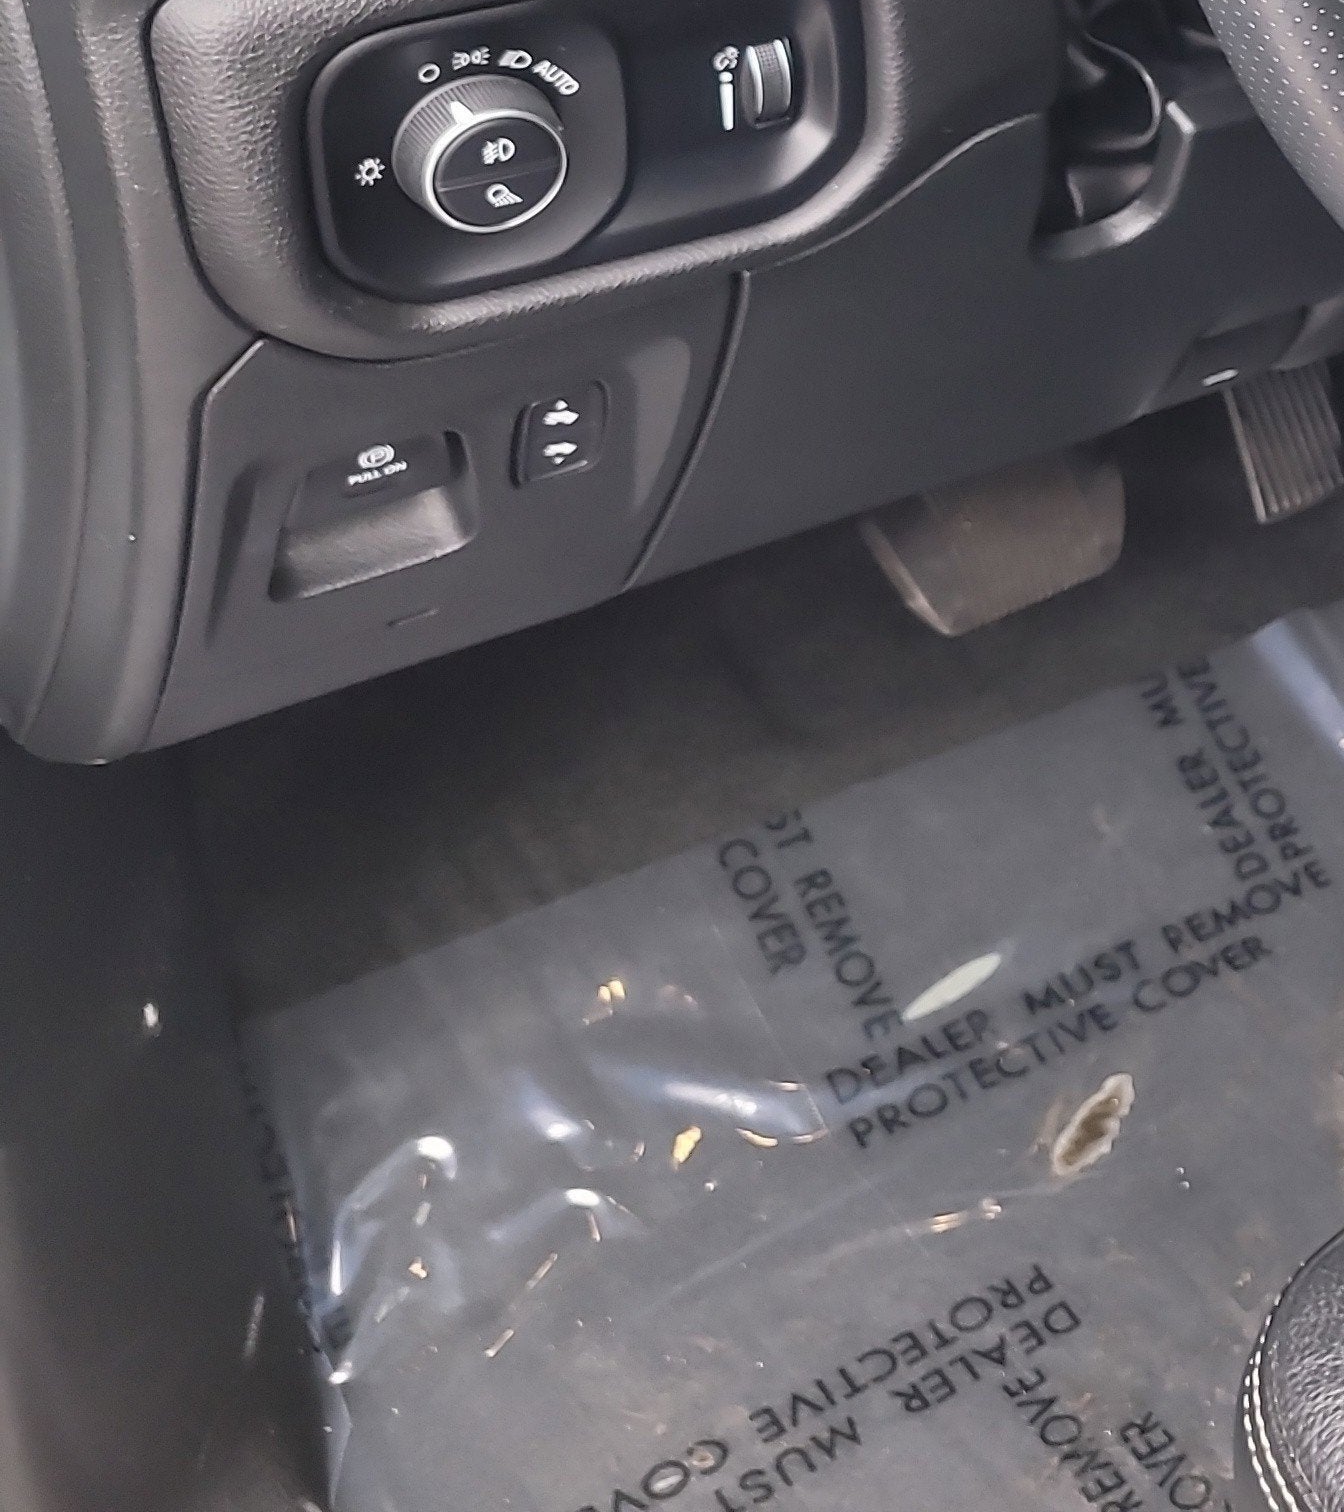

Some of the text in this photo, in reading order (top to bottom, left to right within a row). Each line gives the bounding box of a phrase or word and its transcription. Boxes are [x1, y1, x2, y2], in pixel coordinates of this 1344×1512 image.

[532, 59, 580, 97] AUTO
[347, 460, 408, 487] PULL ON
[1177, 750, 1270, 882] DEALER
[717, 838, 807, 976] COVER
[794, 867, 902, 1042] REMOVE
[825, 859, 1332, 1105] DEALER MUST REMOVE
[848, 935, 1273, 1149] PROTECTIVE COVER
[580, 1263, 1056, 1512] PROTECTIVE COV
[714, 1300, 1082, 1512] DEALER MUST
[1119, 1411, 1214, 1512] OVER
